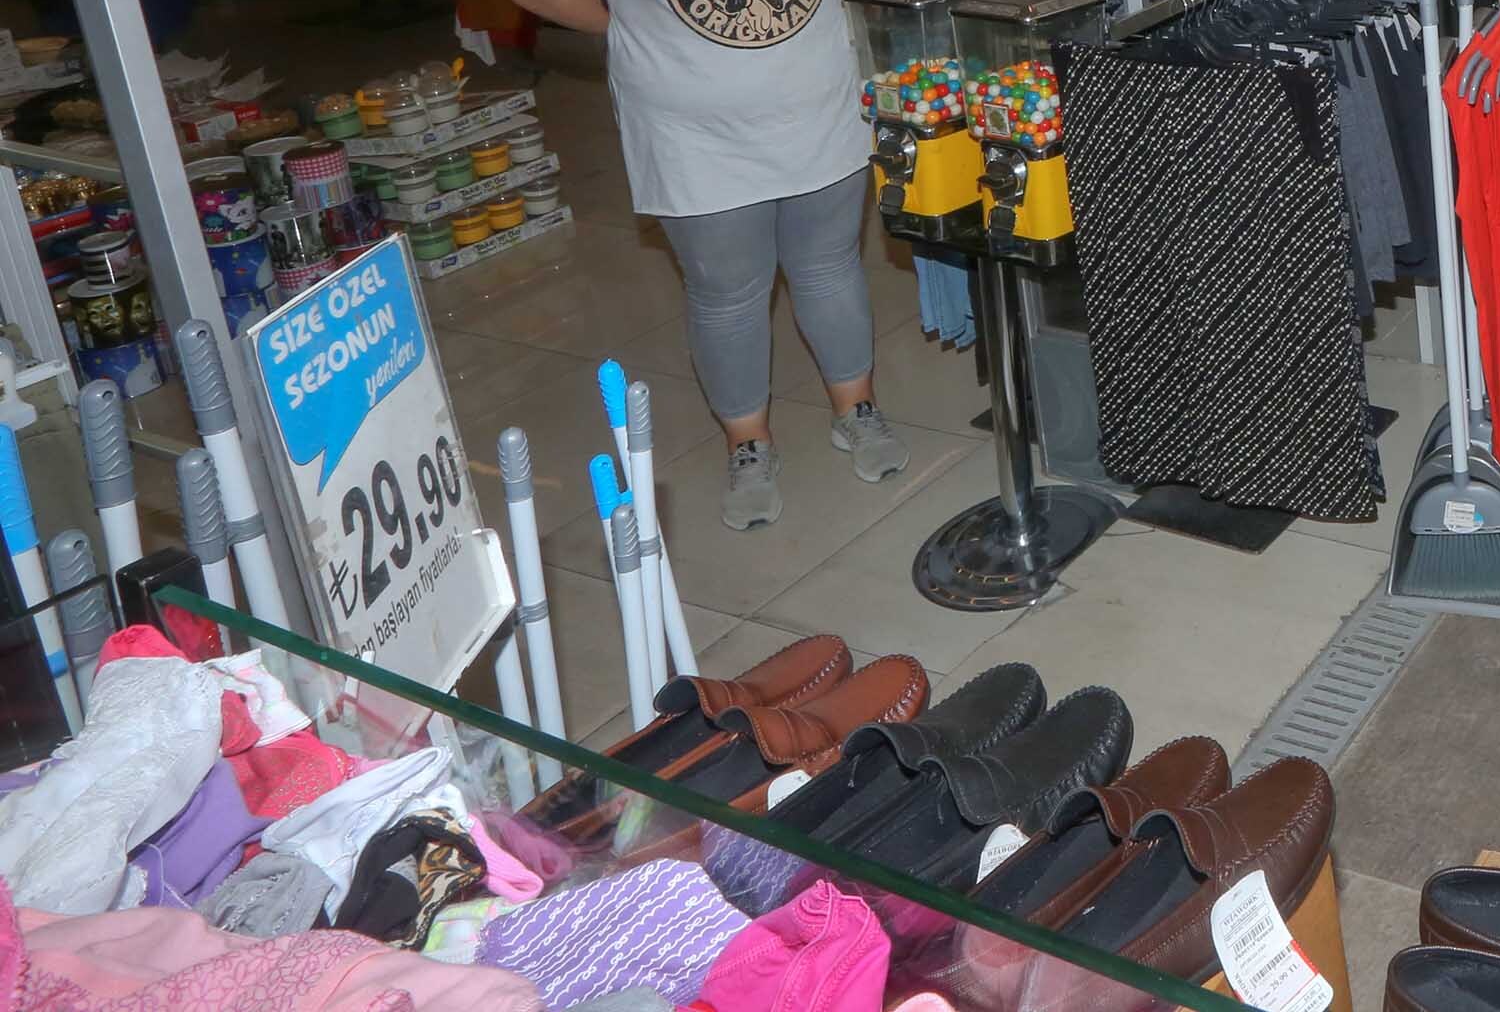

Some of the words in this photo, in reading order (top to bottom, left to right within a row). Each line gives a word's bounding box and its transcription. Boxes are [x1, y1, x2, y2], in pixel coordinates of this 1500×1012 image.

[267, 313, 326, 364] SİZE
[327, 261, 388, 309] ÖZEL
[283, 303, 396, 410] SEZONUN
[365, 342, 418, 406] yenileri
[373, 580, 423, 654] başlayan
